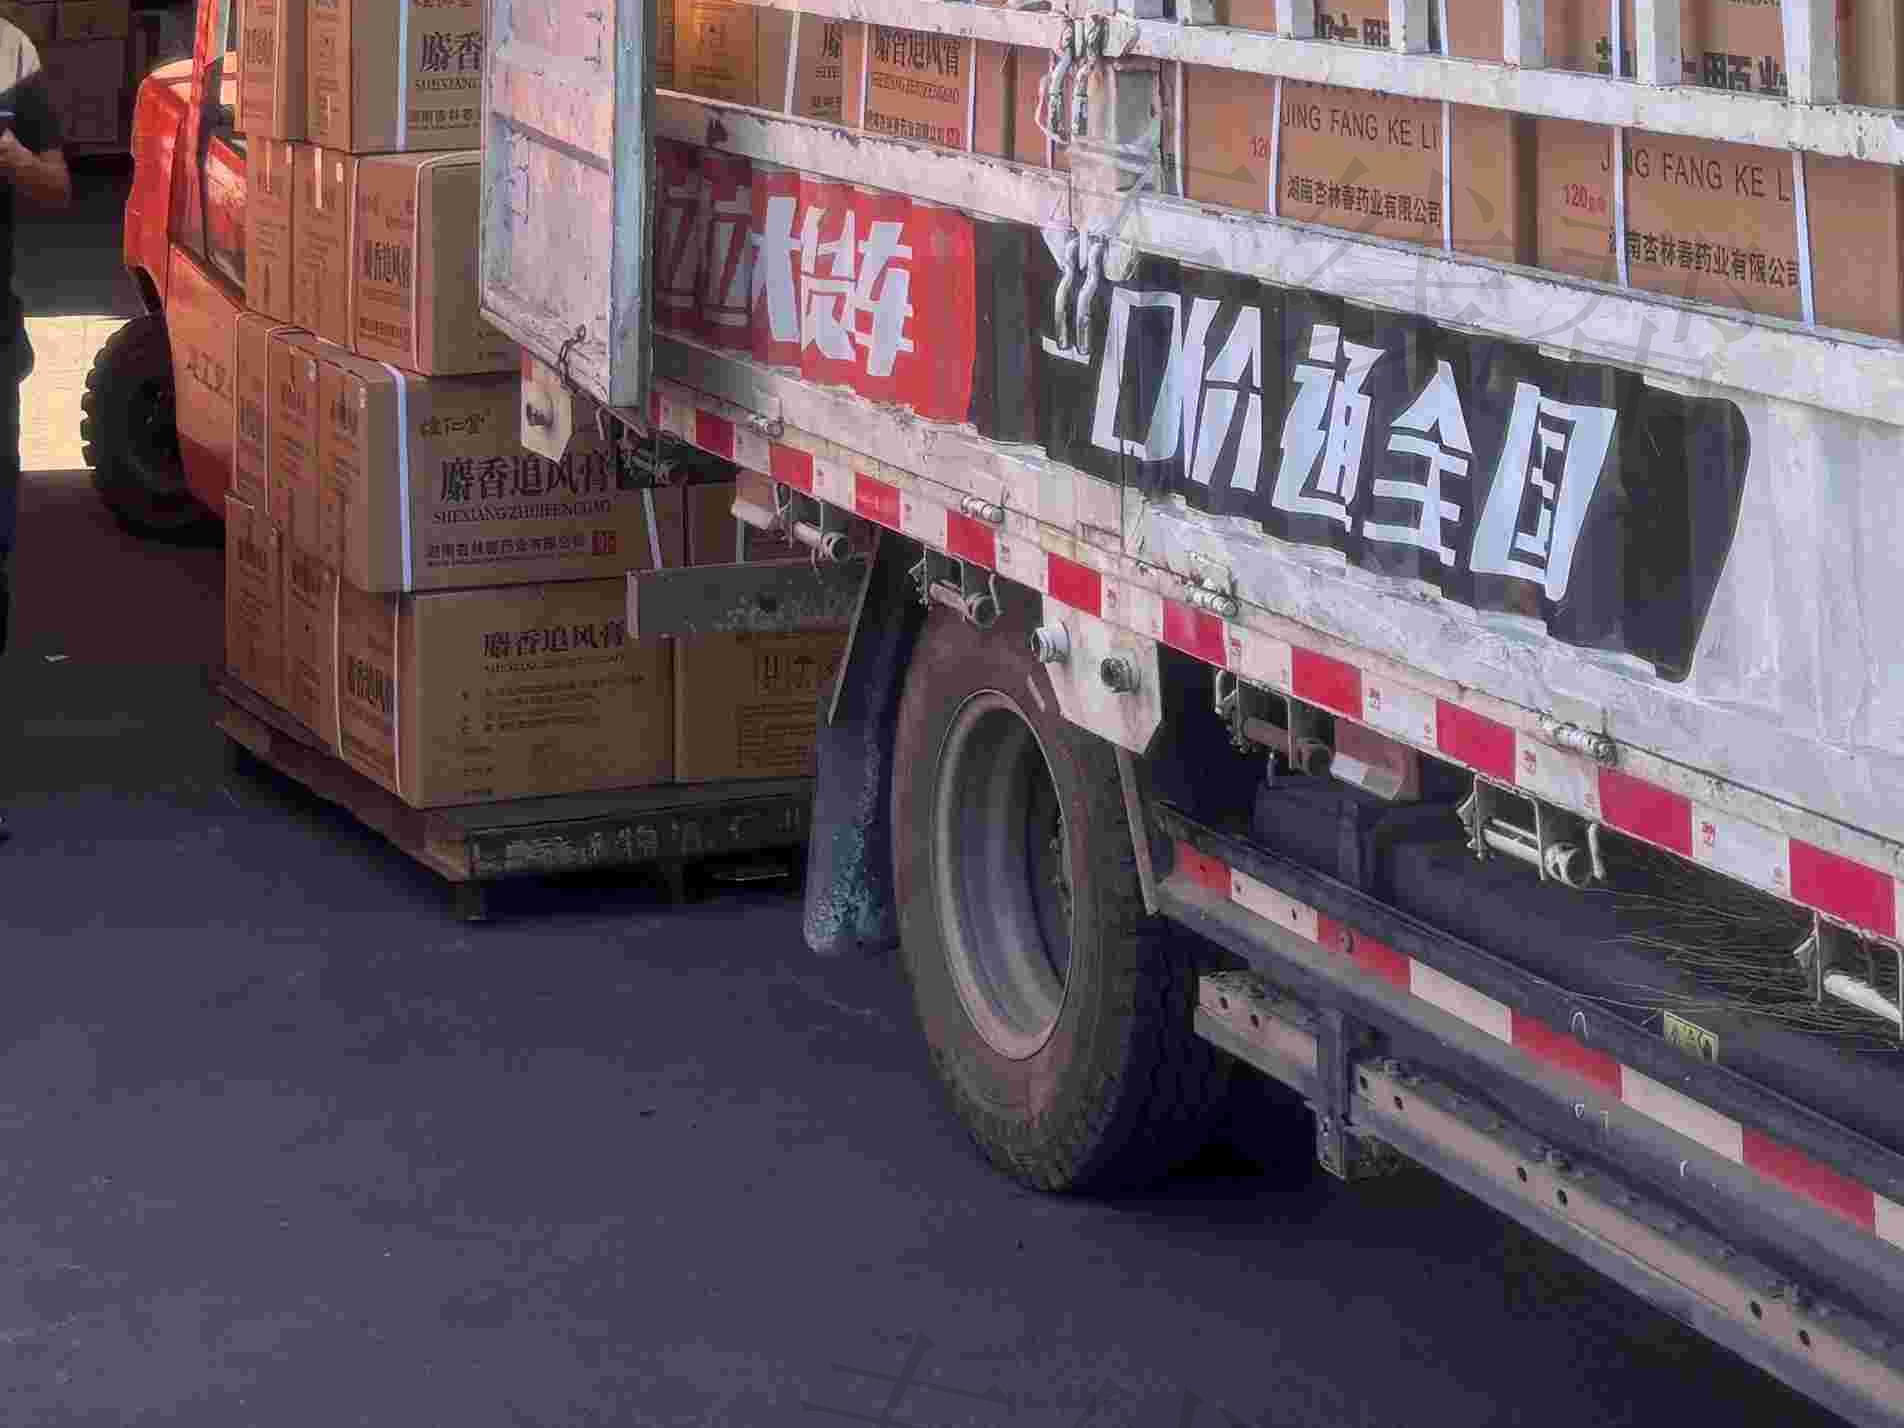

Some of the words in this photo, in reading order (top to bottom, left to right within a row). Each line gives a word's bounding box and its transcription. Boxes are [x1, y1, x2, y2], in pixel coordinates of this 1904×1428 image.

[1329, 108, 1378, 142] FANG
[1387, 118, 1413, 147] KE
[1663, 151, 1723, 191] FANG
[1734, 162, 1766, 198] KE
